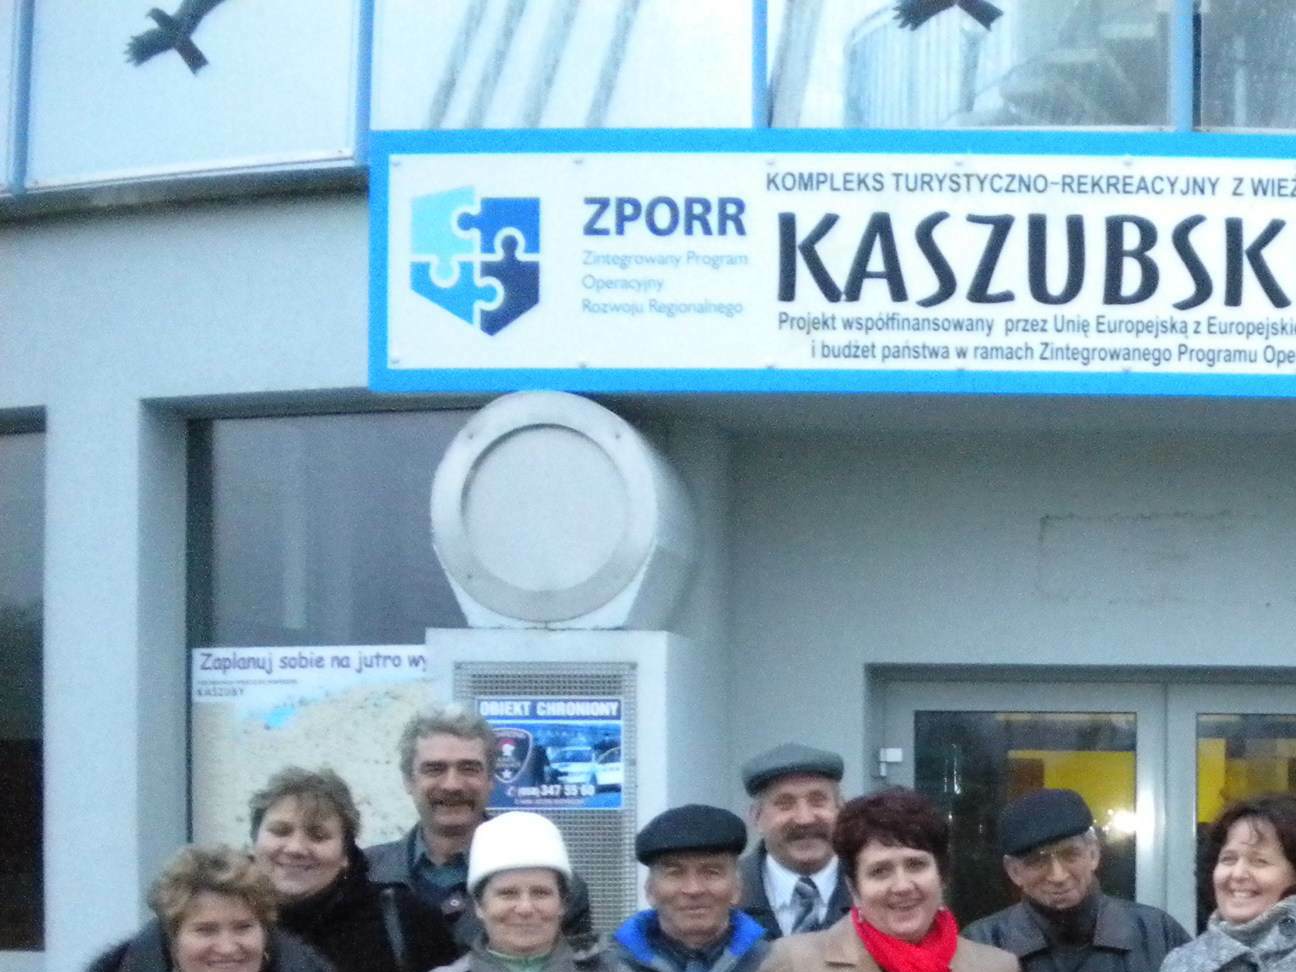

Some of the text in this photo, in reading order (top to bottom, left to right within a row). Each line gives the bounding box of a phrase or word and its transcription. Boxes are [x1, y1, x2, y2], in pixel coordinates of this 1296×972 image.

[766, 171, 885, 192] KOMPLEKS
[892, 172, 1220, 197] TURYSTYCZNO-REKREACYJNY
[1231, 177, 1245, 197] Z
[582, 195, 748, 237] ZPORR
[582, 250, 749, 270] Zintegrowany Program
[582, 273, 665, 292] Operacyjny
[582, 298, 744, 318] Rozwoju Regionalnego
[778, 311, 837, 335] Projekt
[842, 312, 995, 337] współfinansowany
[1004, 318, 1049, 337] przez
[1053, 314, 1091, 338] Unię
[1096, 315, 1189, 340] Europejską
[1193, 320, 1202, 334] z
[810, 339, 816, 359] i
[821, 340, 877, 360] budżet
[880, 340, 951, 363] państwa
[955, 345, 969, 360] w
[973, 342, 1034, 361] ramach
[1038, 341, 1173, 367] Zintegrowanego
[1177, 343, 1258, 368] Programu
[200, 651, 273, 675] Zaplanuj
[278, 651, 325, 670] sobie
[330, 652, 351, 669] na
[356, 651, 401, 673] jutro
[480, 701, 619, 717] OBIEKT CHRONIONY
